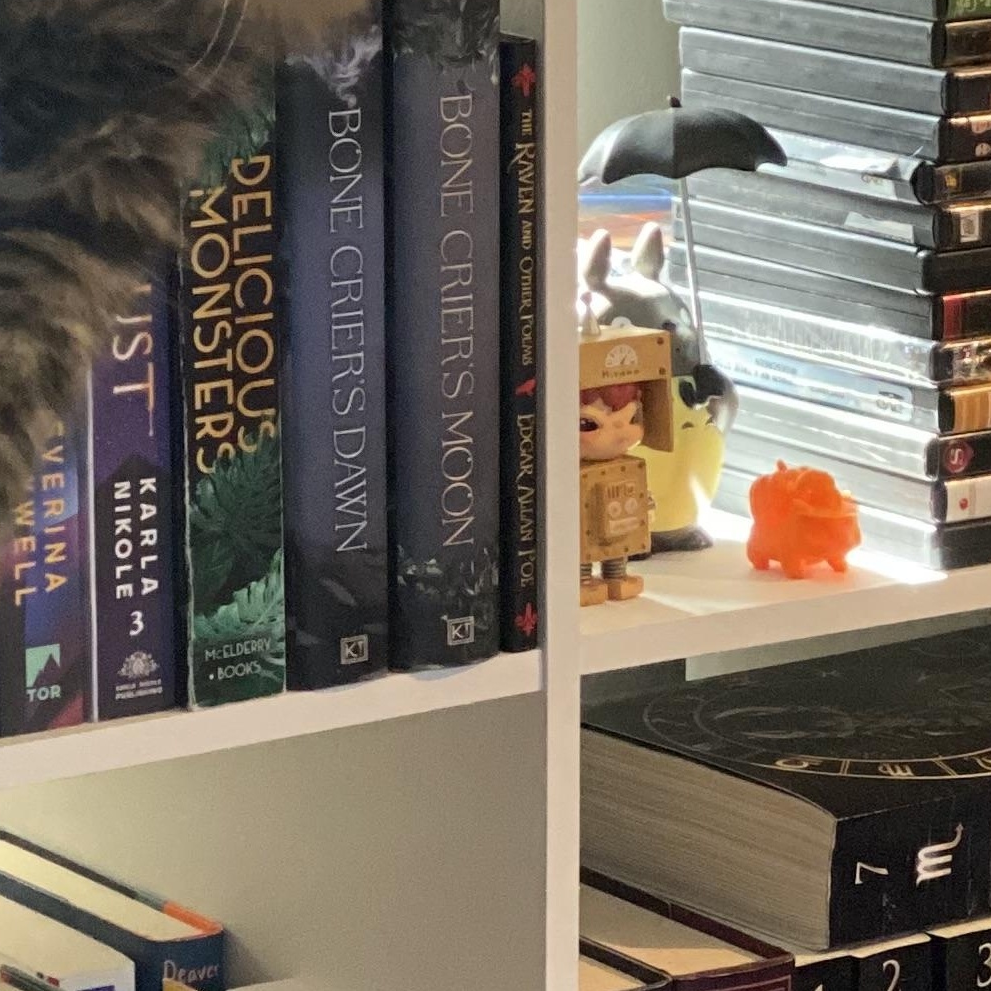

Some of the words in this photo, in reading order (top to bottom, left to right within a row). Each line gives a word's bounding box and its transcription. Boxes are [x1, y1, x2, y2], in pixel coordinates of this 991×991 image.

[440, 94, 474, 218] BONE
[521, 110, 533, 136] THE
[328, 107, 364, 234] BONE
[511, 142, 535, 214] RAVEN
[521, 220, 533, 250] AND
[231, 155, 276, 452] DELICIOUS
[441, 229, 475, 399] CRIER'S
[518, 256, 534, 313] OTHER
[189, 186, 237, 475] MONSTERS
[330, 245, 366, 416] CRIER'S
[521, 313, 534, 366] POEMS
[441, 410, 475, 547] MOON
[516, 413, 535, 484] EDGAR
[41, 421, 69, 593] VERINA
[333, 426, 368, 553] DAWN
[516, 485, 535, 542] ALLAN
[114, 481, 134, 601] NIKOLE
[139, 477, 159, 596] KARLA
[517, 549, 536, 588] POE
[129, 611, 145, 637] 3
[205, 638, 272, 662] McELDERRY
[26, 684, 62, 703] TOR
[217, 660, 261, 680] BOOKS
[854, 861, 889, 886] 7
[882, 959, 902, 991] 2
